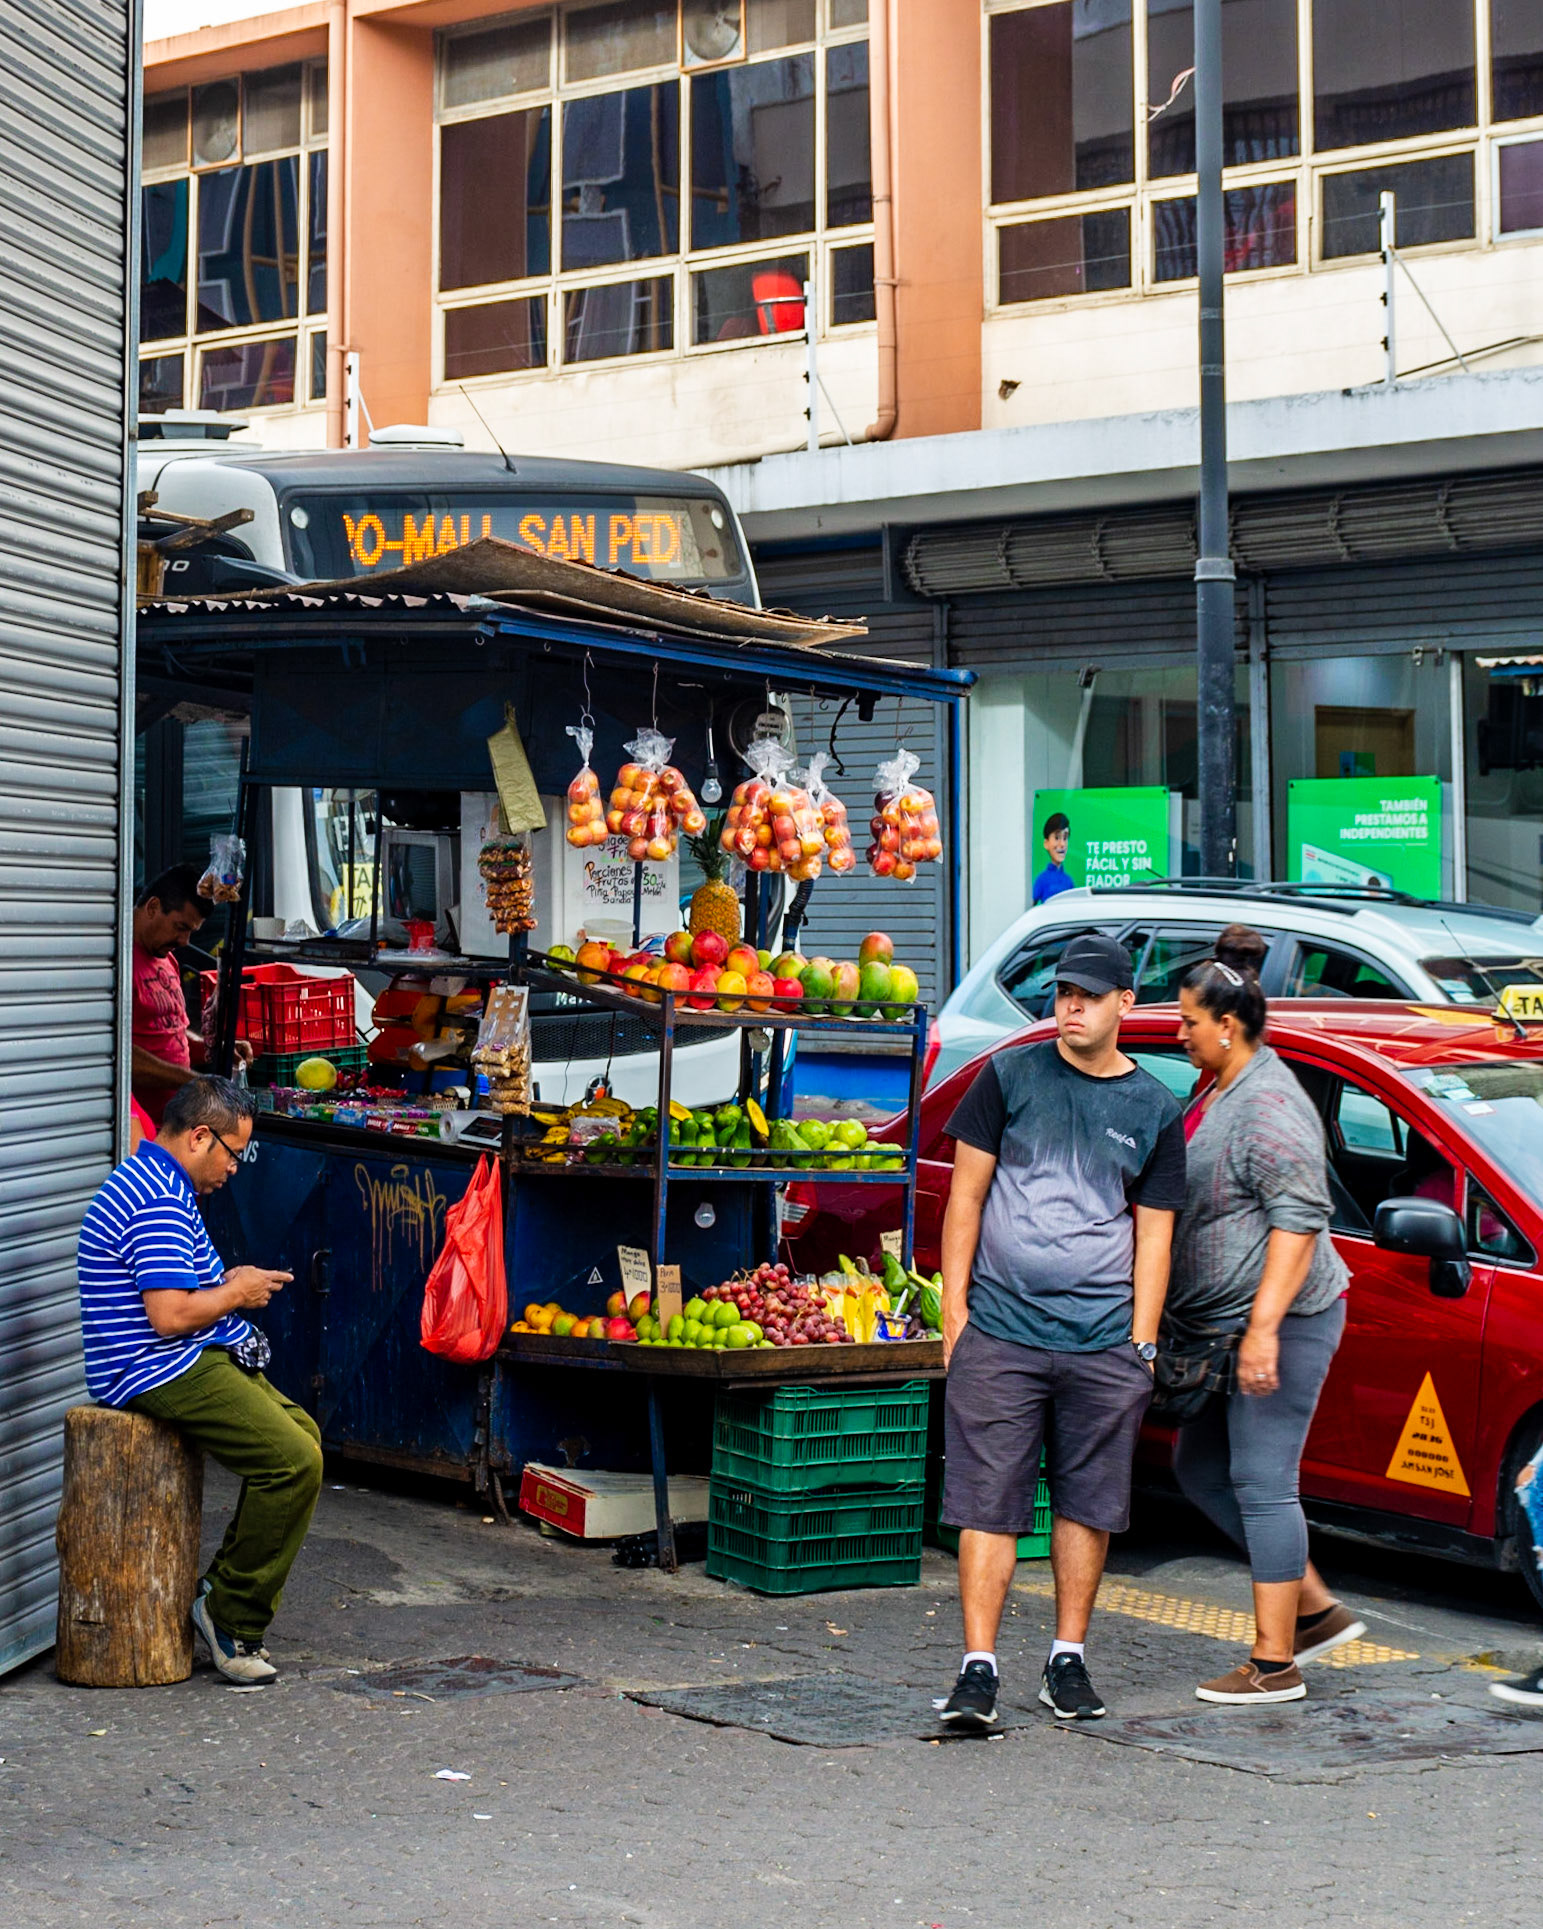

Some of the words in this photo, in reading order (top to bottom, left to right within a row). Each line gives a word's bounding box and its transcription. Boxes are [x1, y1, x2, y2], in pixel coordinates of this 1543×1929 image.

[519, 514, 595, 563] SAN
[609, 514, 683, 564] PED
[1380, 797, 1428, 811] TAMBIÉN
[1355, 813, 1417, 826] PRESTAMOS
[1418, 812, 1428, 825] A
[1340, 827, 1428, 839] INDEPENDIENTES
[1086, 841, 1100, 855] TE
[1102, 840, 1147, 854] PRESTO
[1086, 854, 1119, 871] FÁCIL
[1122, 858, 1130, 871] Y
[1132, 857, 1152, 870] SIN
[1086, 874, 1130, 888] FIADOR
